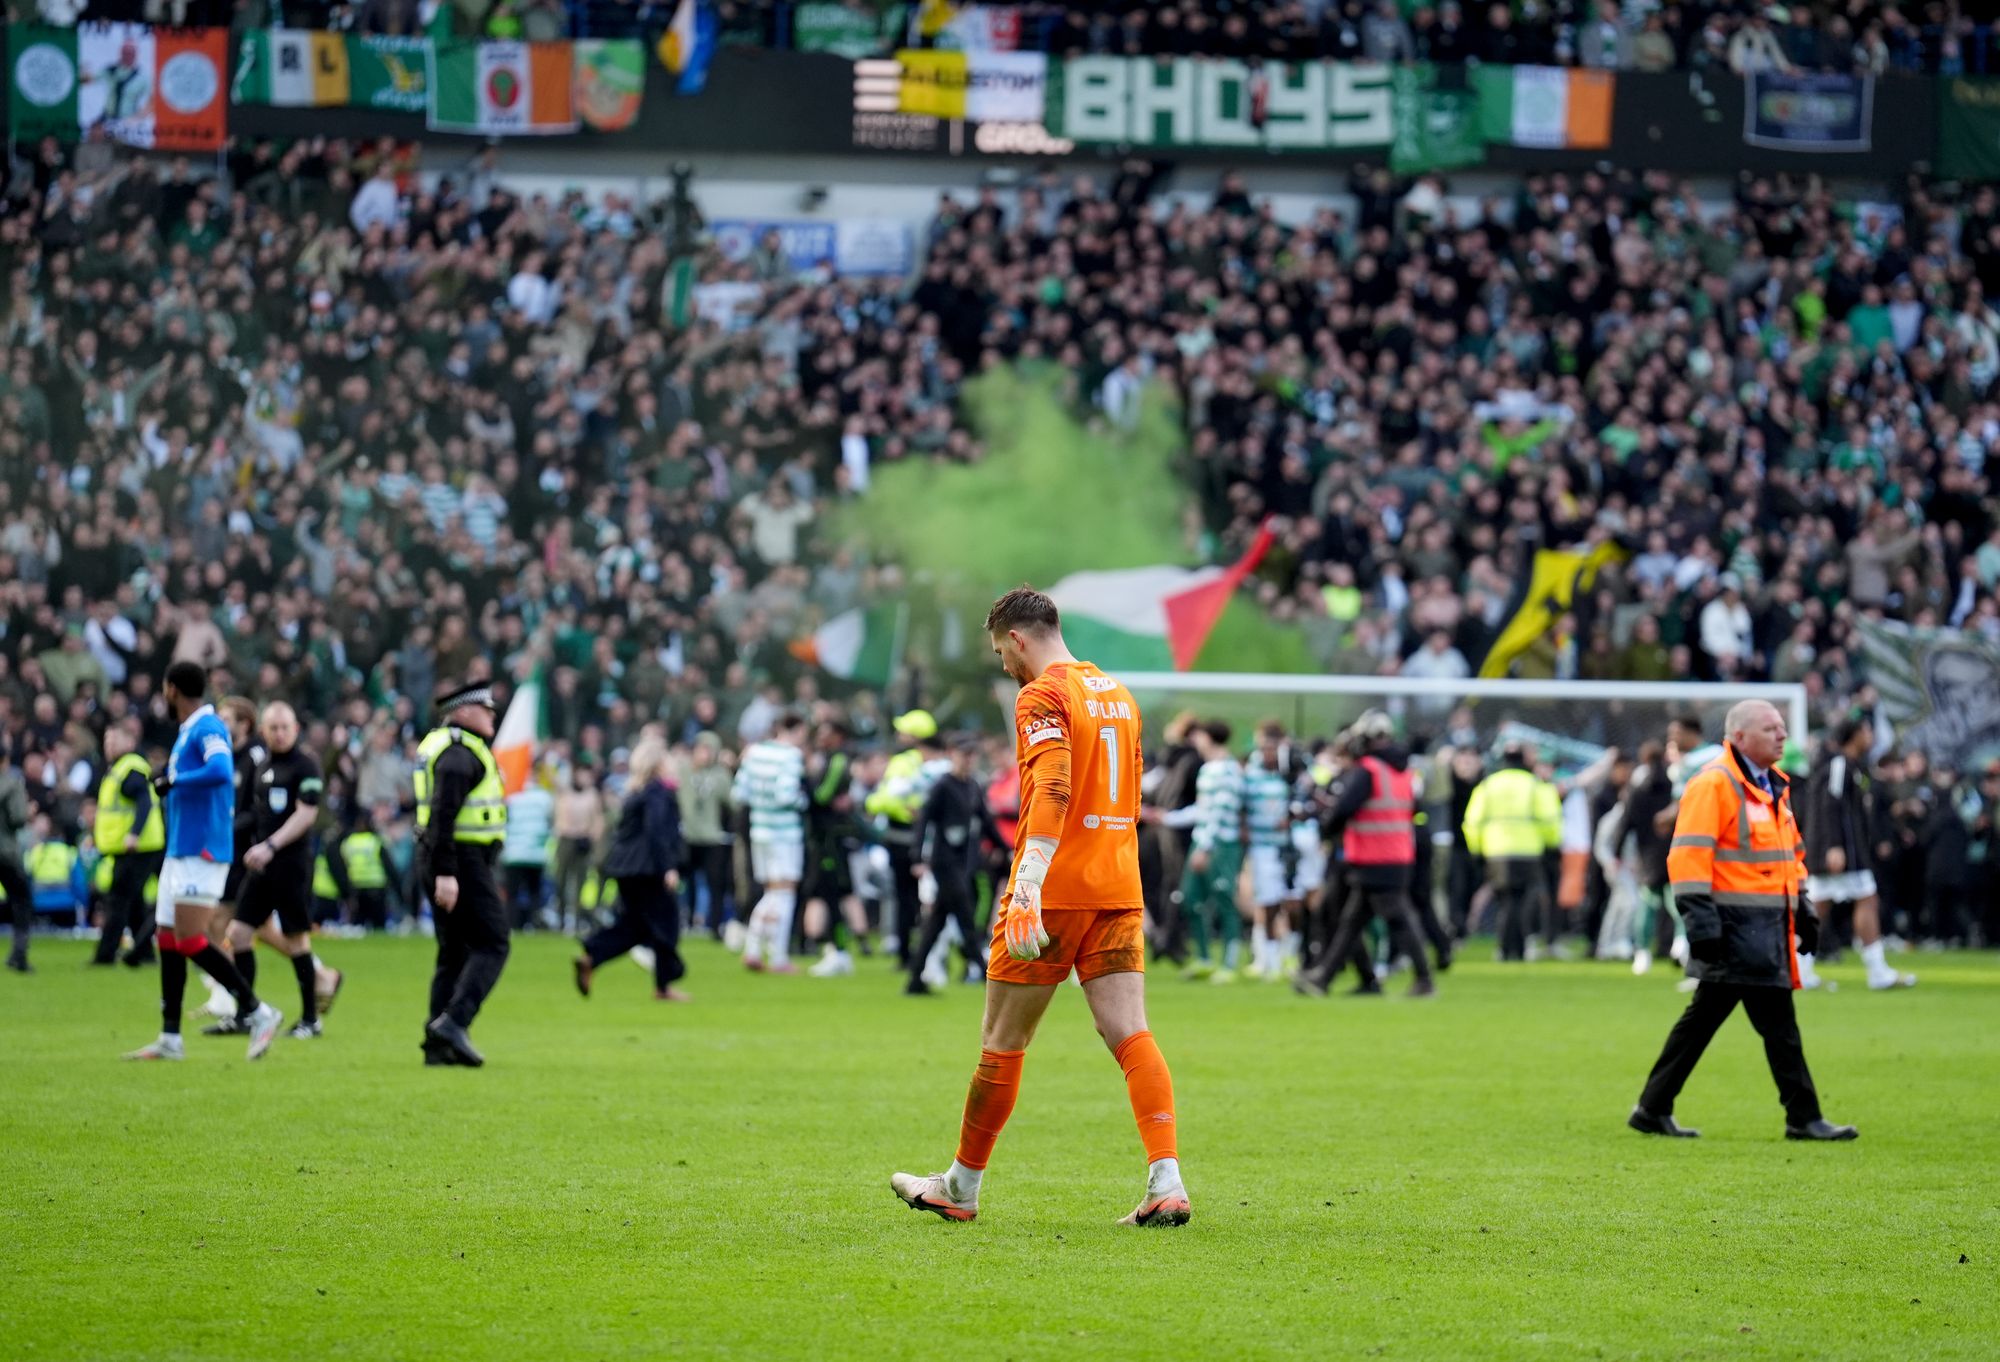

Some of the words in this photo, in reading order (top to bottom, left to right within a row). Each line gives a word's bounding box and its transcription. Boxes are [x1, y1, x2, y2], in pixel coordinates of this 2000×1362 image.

[1064, 56, 1395, 145] BHOYS
[1025, 717, 1059, 735] BOXT
[1085, 699, 1132, 720] BLAND
[1099, 725, 1119, 804] 1
